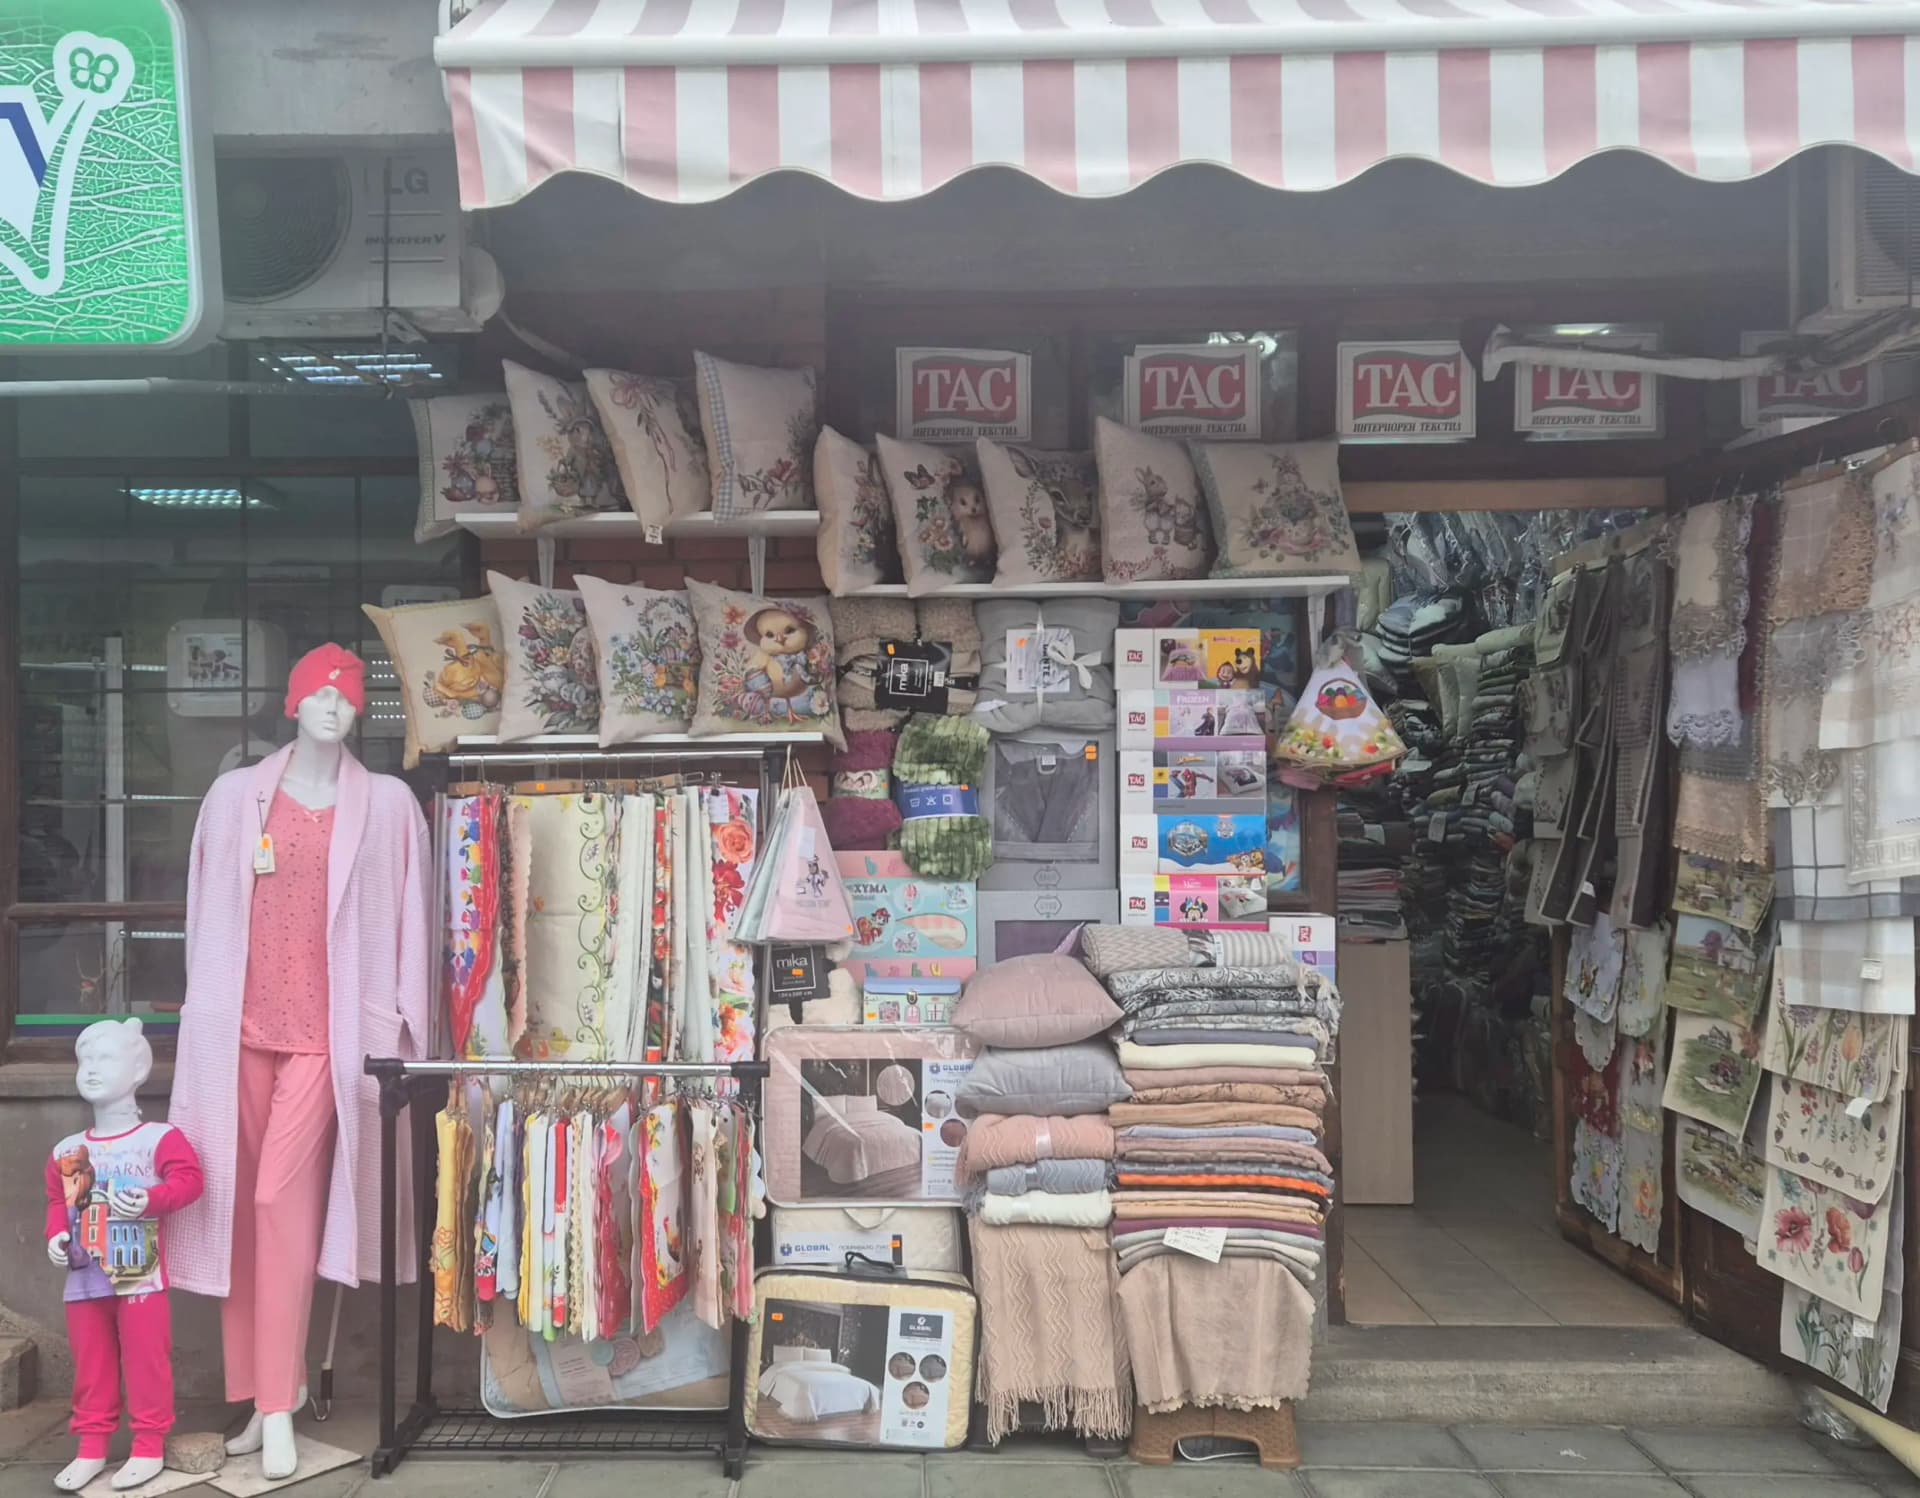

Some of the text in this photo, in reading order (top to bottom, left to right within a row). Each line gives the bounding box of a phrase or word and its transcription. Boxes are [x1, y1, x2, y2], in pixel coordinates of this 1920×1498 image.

[384, 168, 429, 195] LG
[917, 367, 1013, 412] TAC
[1144, 365, 1242, 410] TAC
[1358, 362, 1457, 408] TAC
[1420, 421, 1462, 432] ТЕКСТИЛ
[776, 952, 808, 968] mika
[795, 1243, 831, 1252] GLOBAL
